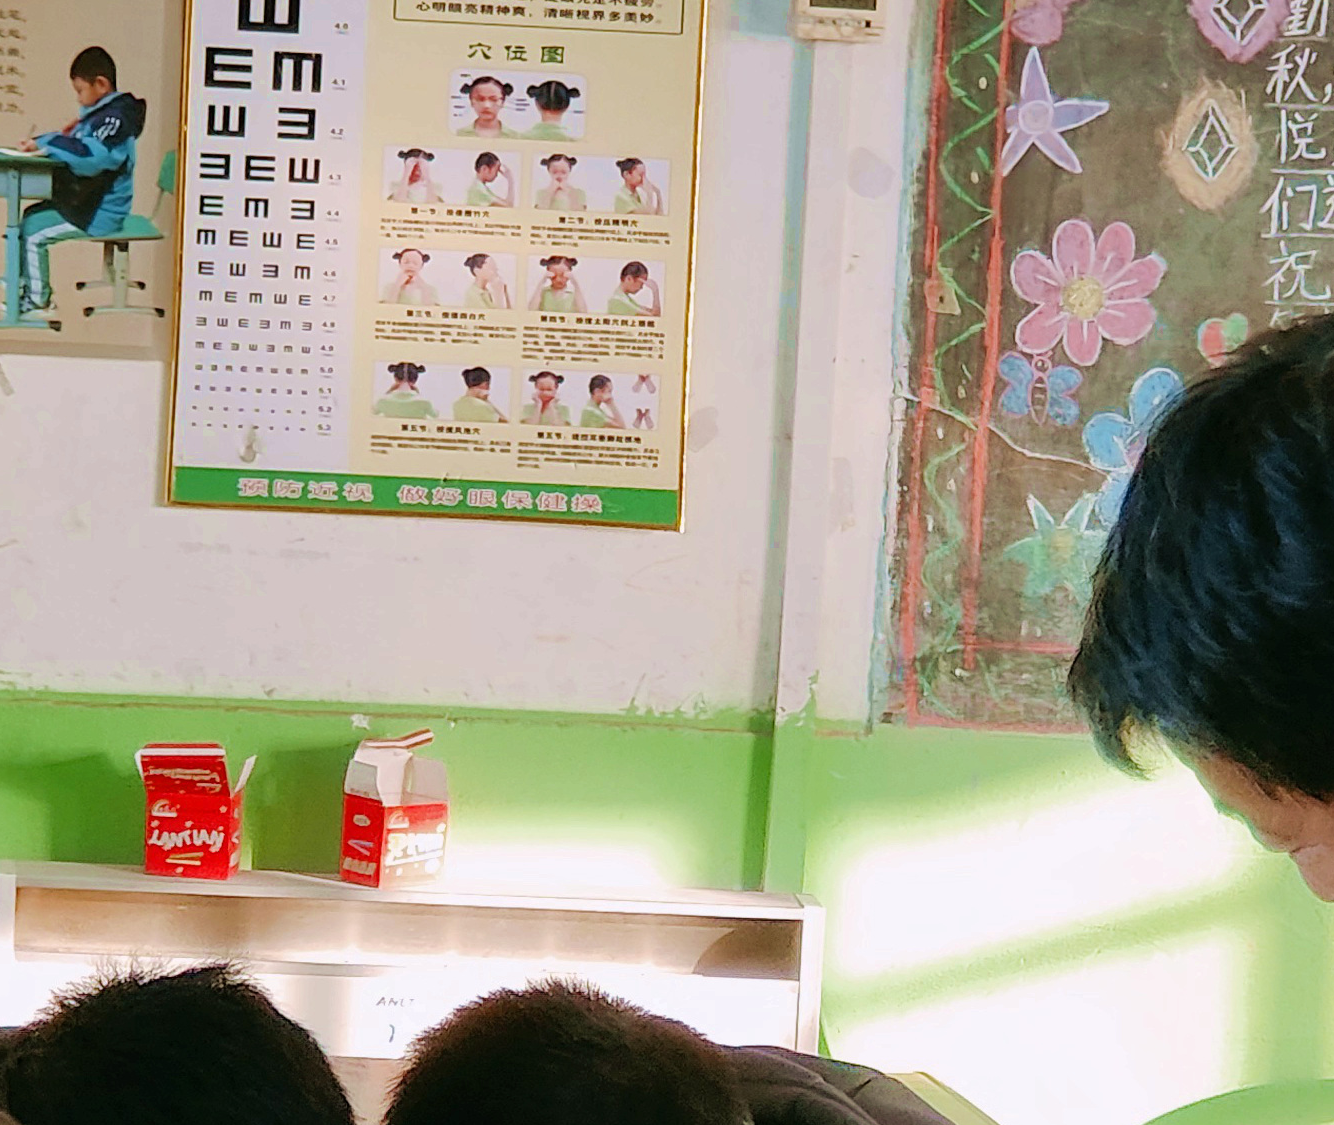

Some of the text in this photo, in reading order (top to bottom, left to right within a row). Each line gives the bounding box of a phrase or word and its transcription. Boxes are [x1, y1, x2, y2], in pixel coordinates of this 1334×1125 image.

[467, 42, 565, 64] 穴位图
[238, 477, 603, 514] 预防近视 做好眼保健操
